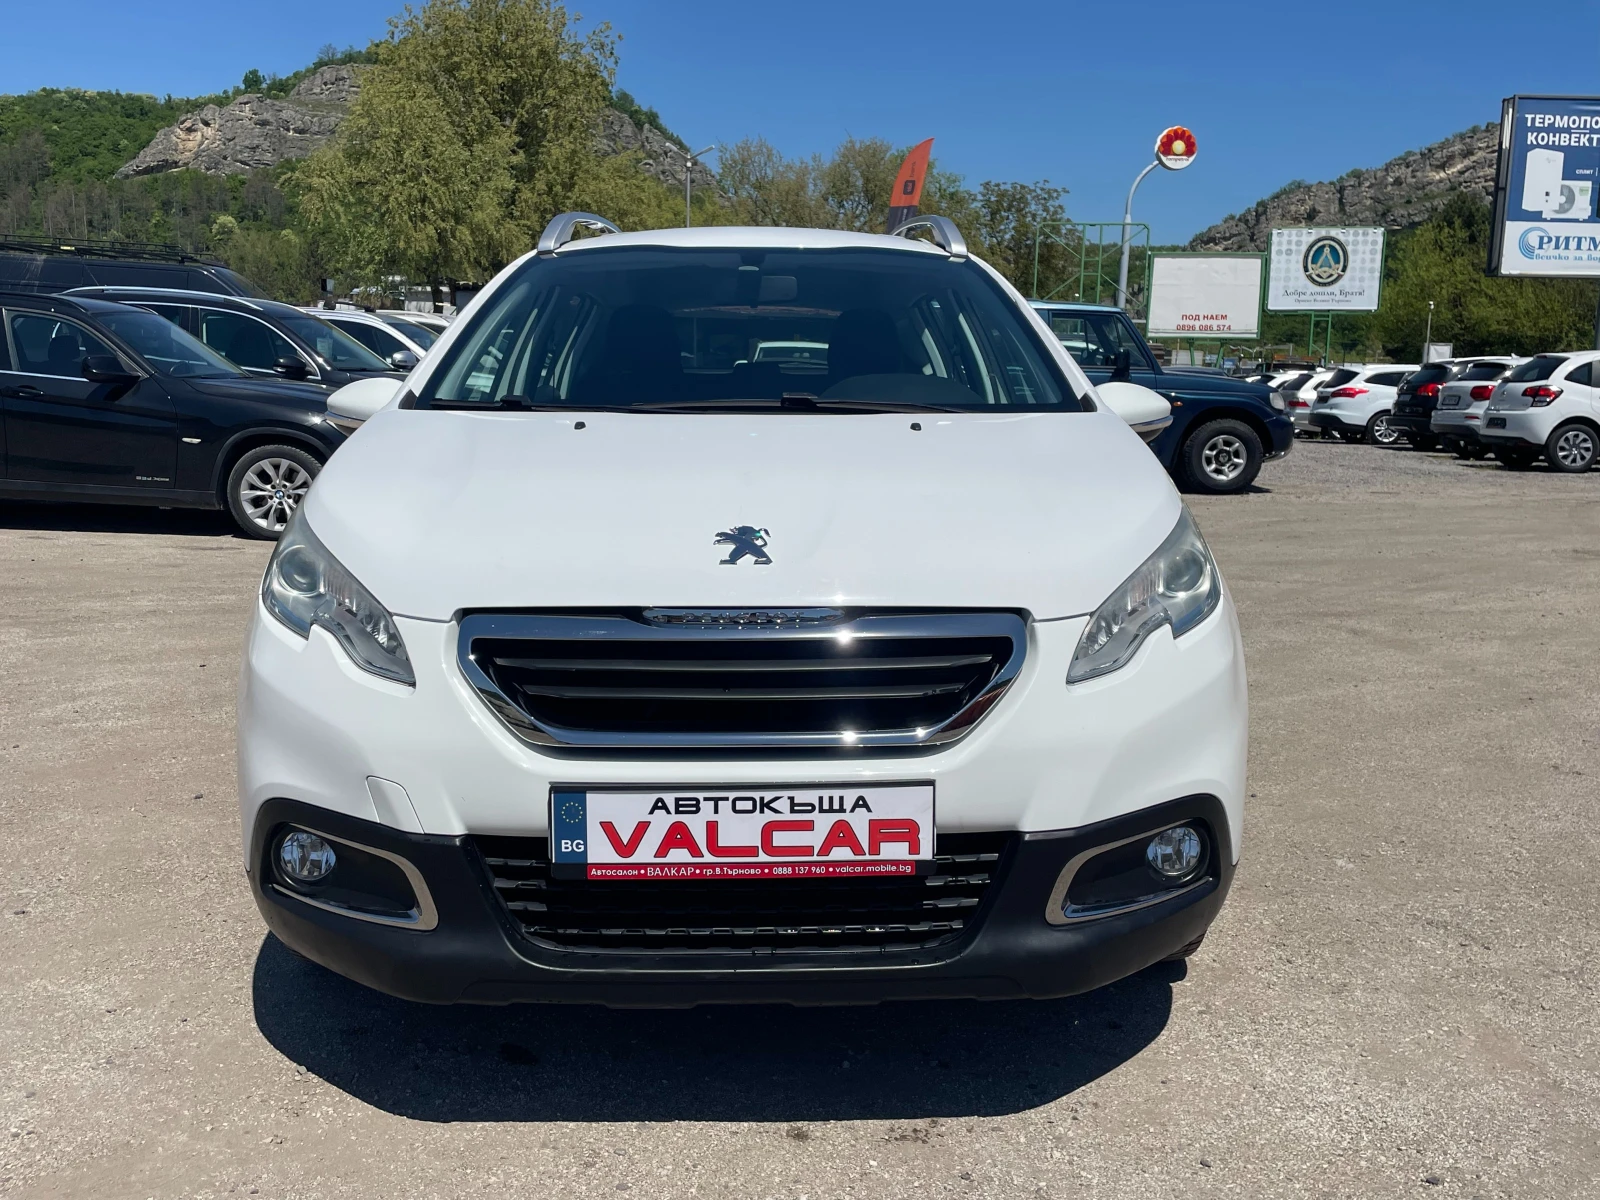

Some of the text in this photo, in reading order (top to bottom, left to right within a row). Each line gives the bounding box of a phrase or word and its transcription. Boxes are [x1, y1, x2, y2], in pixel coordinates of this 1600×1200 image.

[1525, 114, 1600, 129] ТЕРМОПО
[1527, 132, 1600, 147] КОНВЕКТ
[1282, 290, 1307, 298] Добре
[1339, 290, 1365, 298] Братя!
[1181, 314, 1200, 322] ПОД
[648, 795, 873, 815] АВТОКЪЩА
[599, 818, 921, 858] VALCAR
[561, 839, 585, 852] BG
[590, 868, 638, 876] Автосалон
[647, 867, 695, 877] ВАЛКАР
[702, 867, 762, 876] гр.В.Търново
[772, 867, 792, 875] 0888
[811, 866, 826, 874] 960
[835, 864, 912, 873] valcar.mobile.bg
